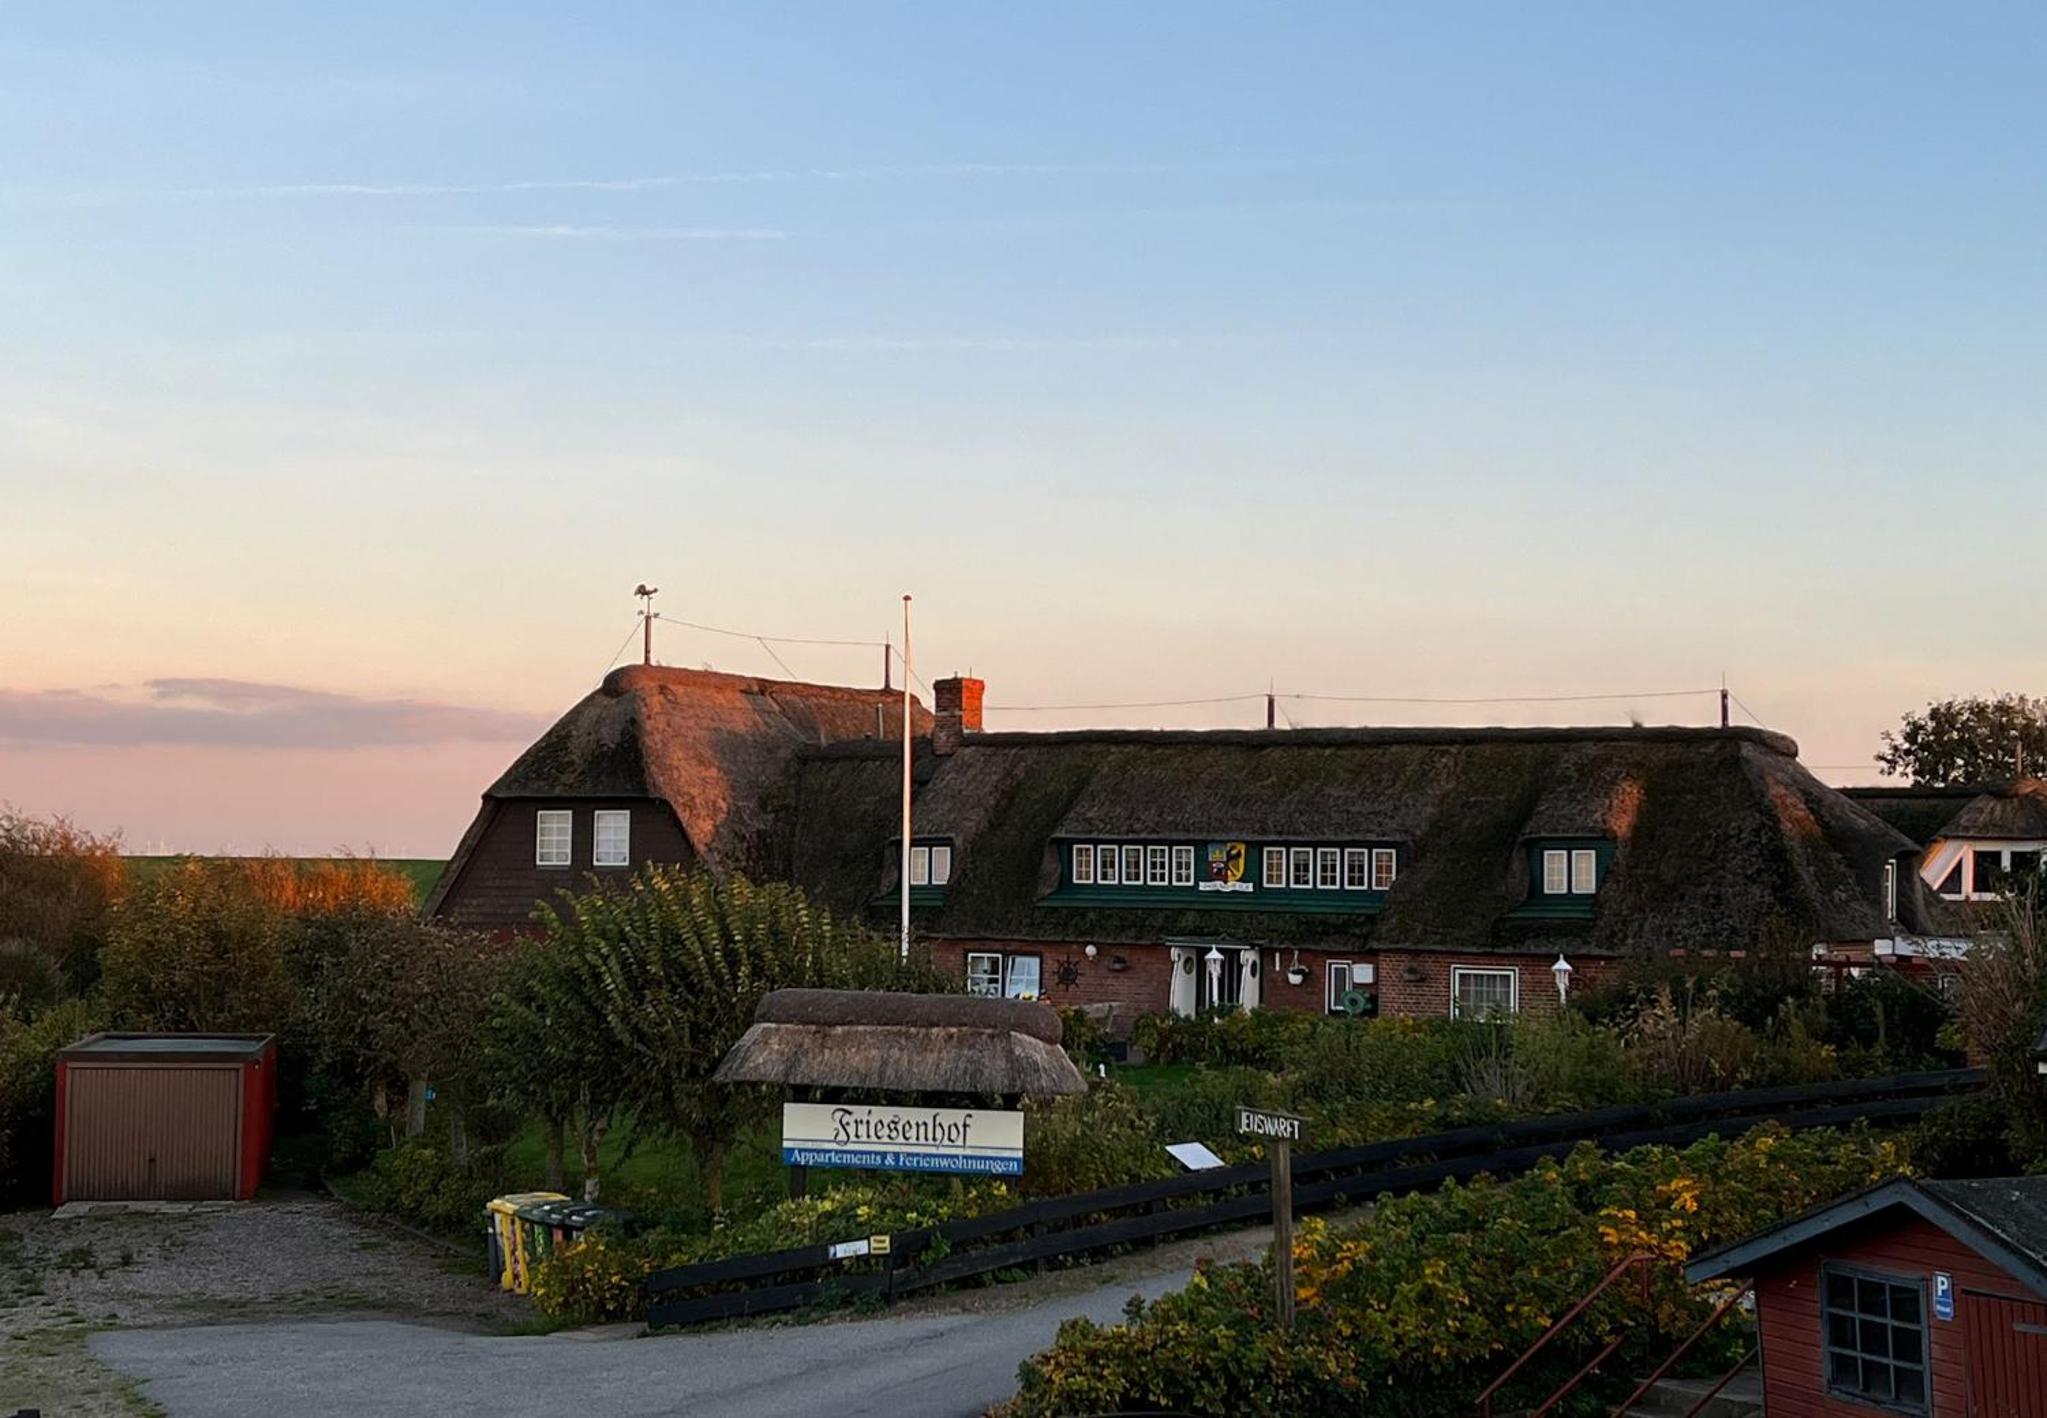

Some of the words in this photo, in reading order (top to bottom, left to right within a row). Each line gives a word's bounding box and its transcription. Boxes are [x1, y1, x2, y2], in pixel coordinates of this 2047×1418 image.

[831, 1107, 973, 1151] Friesenhof
[791, 1148, 881, 1166] Appartements
[884, 1151, 896, 1166] &
[899, 1153, 1018, 1175] Ferienwohnungen
[1937, 1275, 1949, 1297] P
